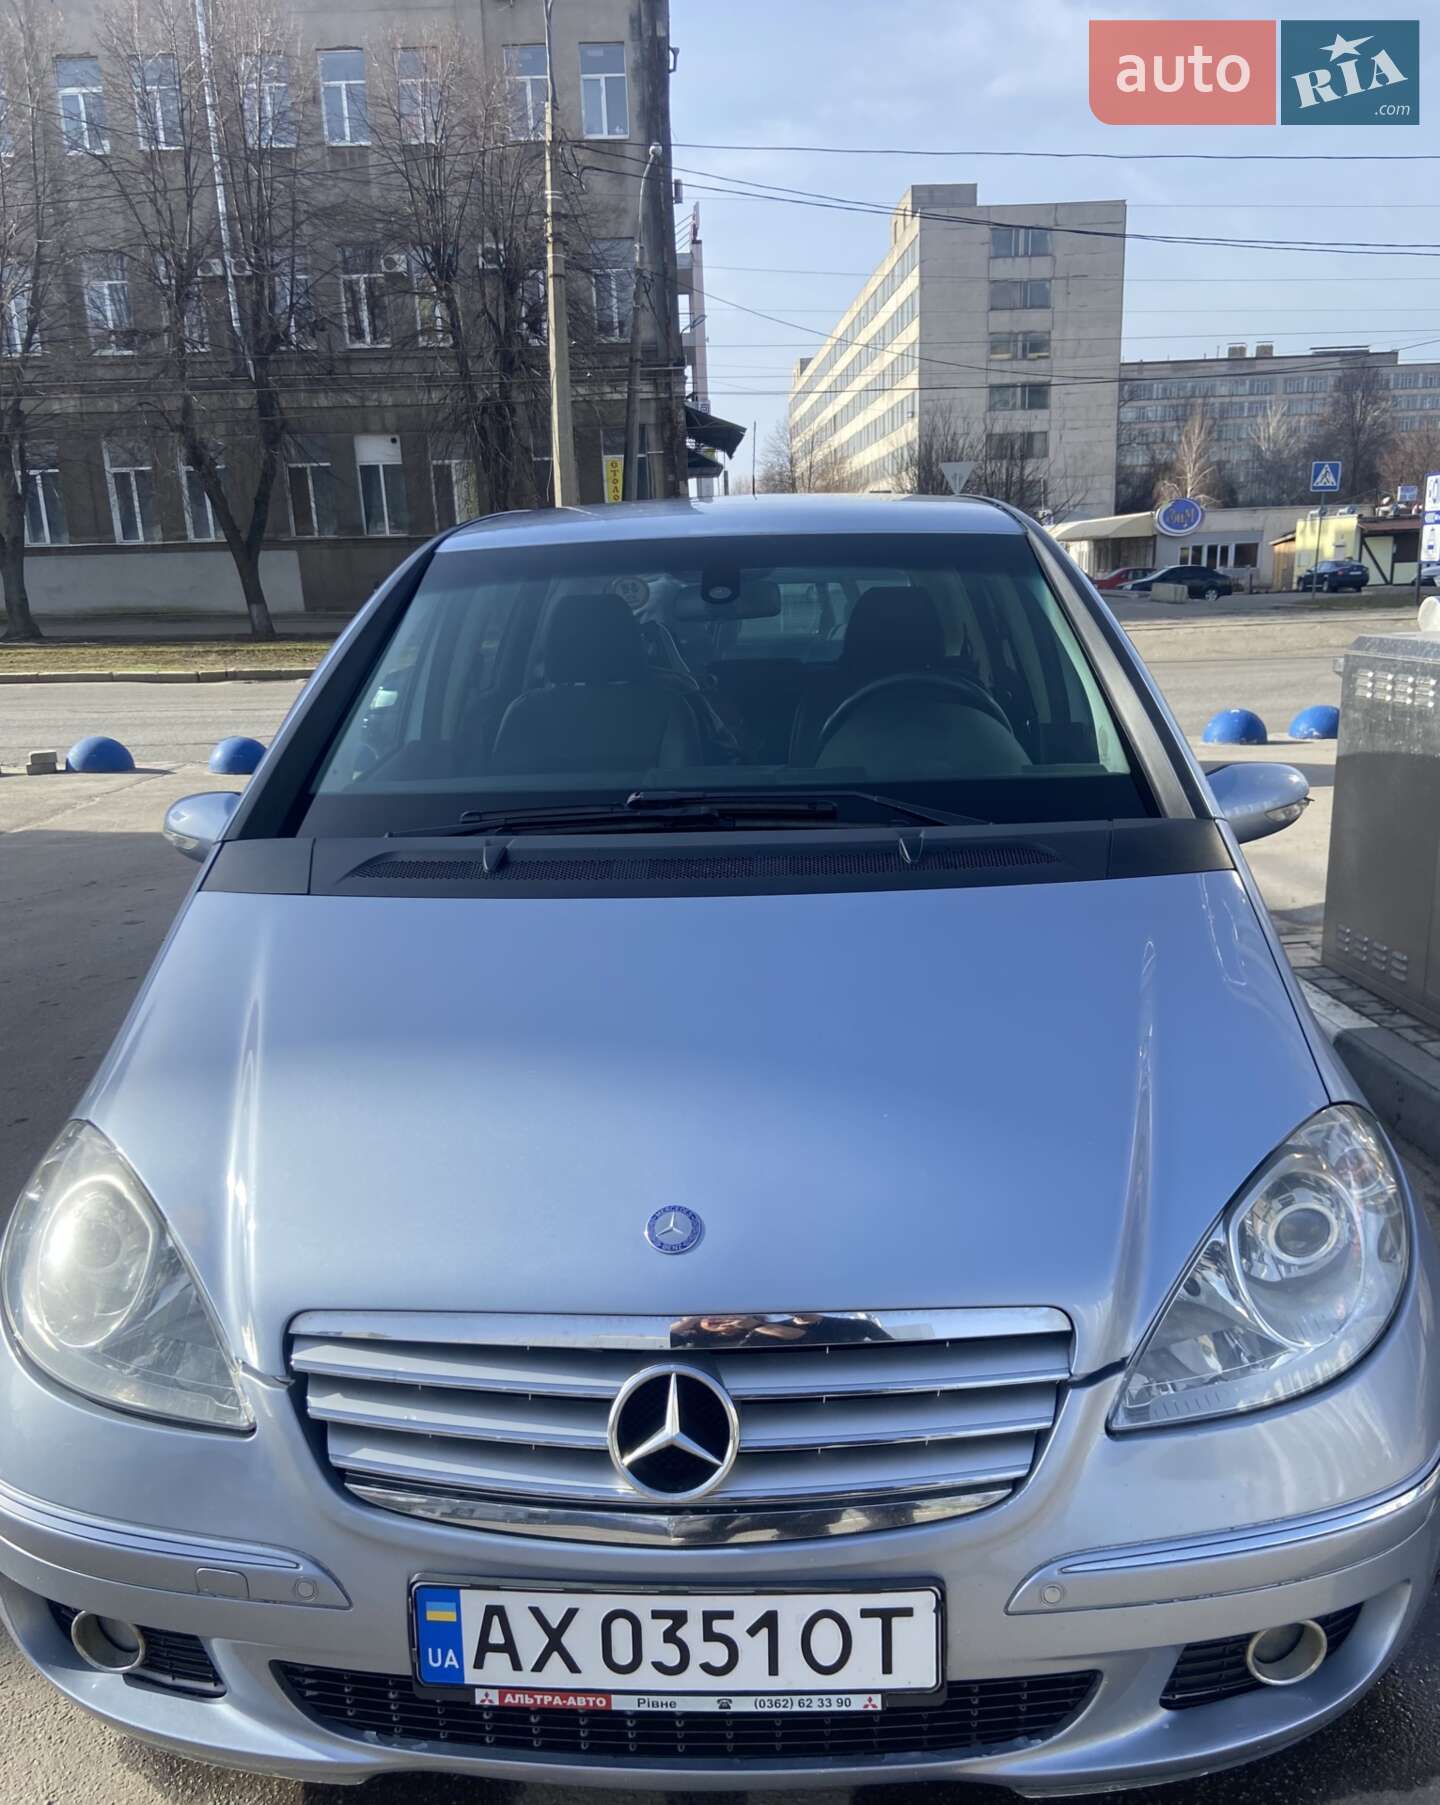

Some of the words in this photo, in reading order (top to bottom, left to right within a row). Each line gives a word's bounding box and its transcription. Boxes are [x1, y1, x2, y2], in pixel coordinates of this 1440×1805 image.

[473, 1604, 582, 1674] AX
[601, 1608, 779, 1677] 0351
[800, 1607, 914, 1677] OT
[428, 1648, 460, 1669] UA
[504, 1693, 607, 1707] АЛЬТРА-АВТО
[637, 1698, 677, 1709] Рівне
[754, 1697, 794, 1709] (0362)
[798, 1697, 813, 1708] 62
[817, 1697, 832, 1708] 33
[836, 1697, 852, 1708] 90
